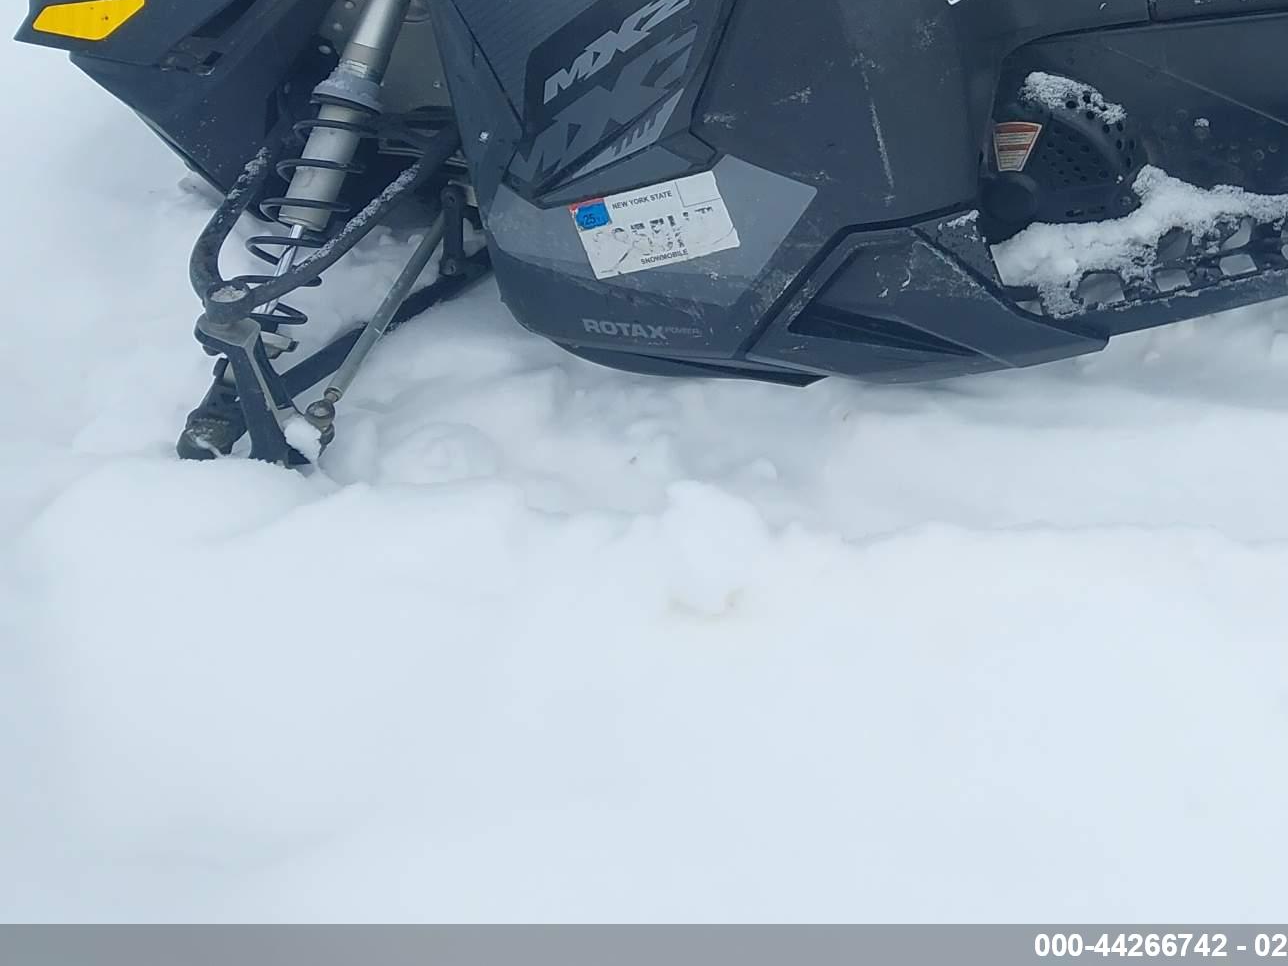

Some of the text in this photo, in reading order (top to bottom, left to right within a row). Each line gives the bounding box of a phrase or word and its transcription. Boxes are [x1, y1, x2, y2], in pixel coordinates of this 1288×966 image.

[612, 190, 673, 210] NEW YORK STATE
[583, 213, 596, 225] 25
[640, 248, 689, 265] SNOWMOBILE
[582, 318, 667, 340] ROTAX
